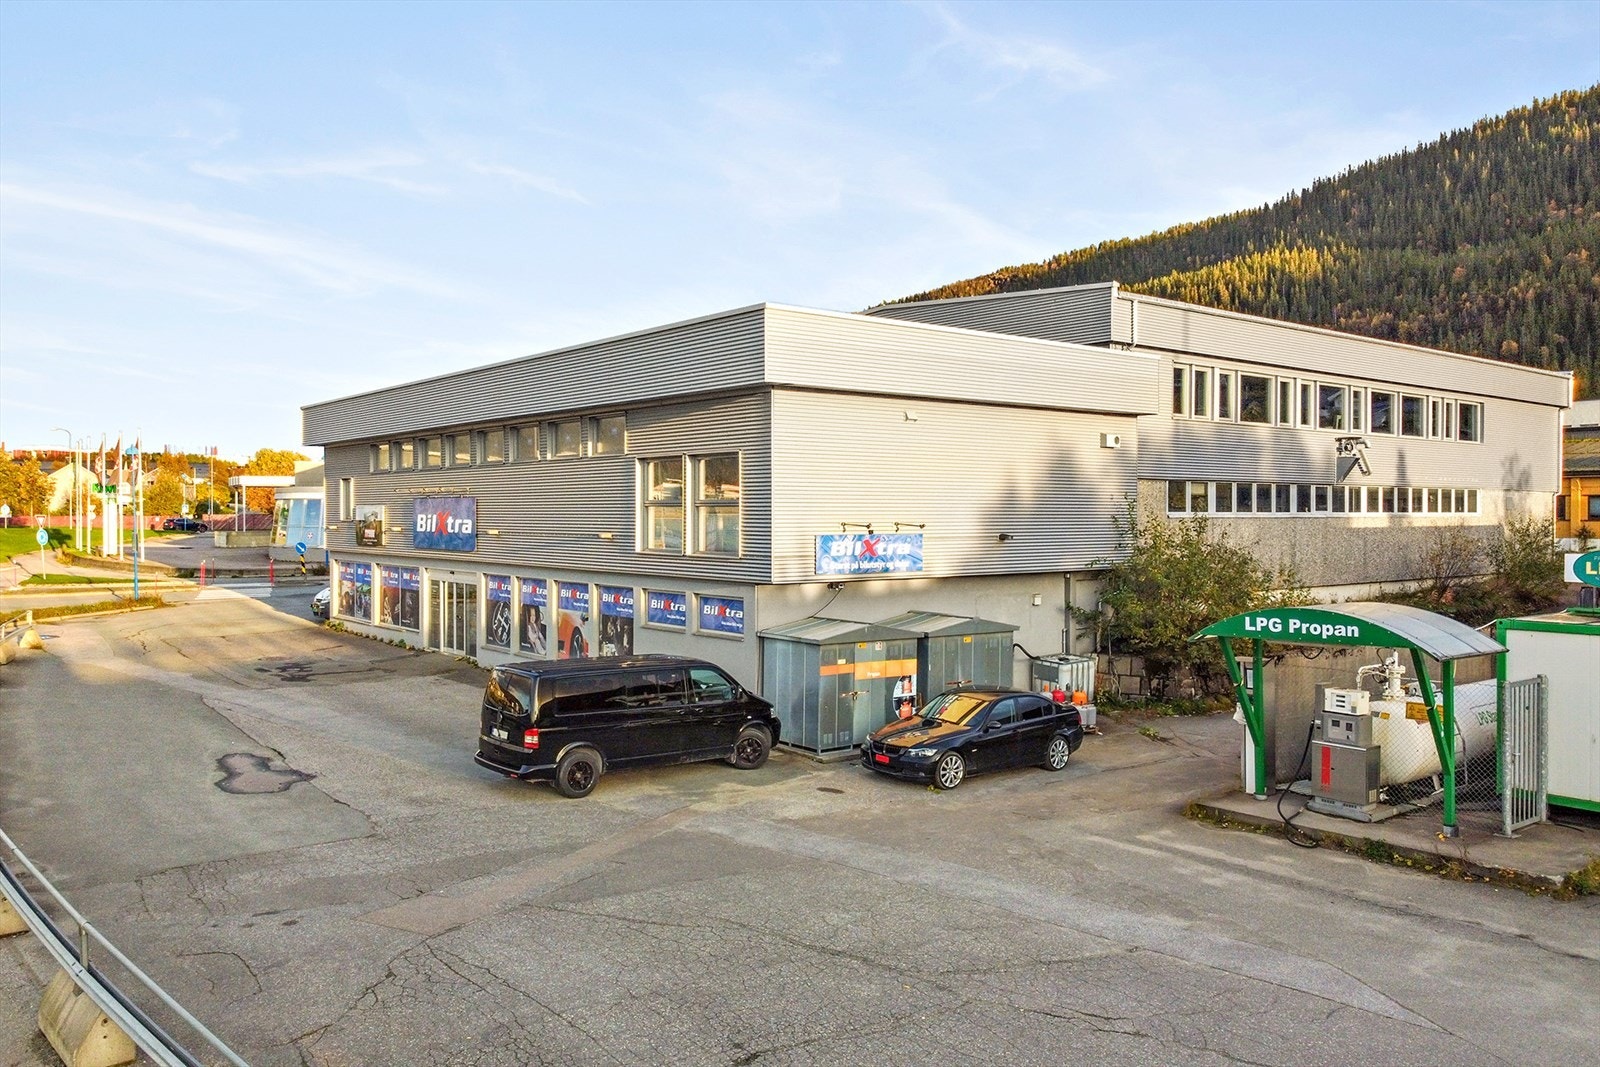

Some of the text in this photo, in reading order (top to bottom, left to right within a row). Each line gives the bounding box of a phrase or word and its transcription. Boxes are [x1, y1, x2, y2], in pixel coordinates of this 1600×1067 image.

[416, 511, 472, 536] BilXtra
[830, 538, 911, 558] BilXtra
[1586, 561, 1600, 575] L
[489, 580, 511, 591] BilXtra
[522, 584, 547, 595] BilXtra
[560, 588, 589, 600] BilXtra
[602, 593, 633, 605] BilXtra
[651, 599, 686, 612] BilXtra
[704, 605, 743, 619] BilXtra
[1245, 616, 1359, 639] LPG Propan
